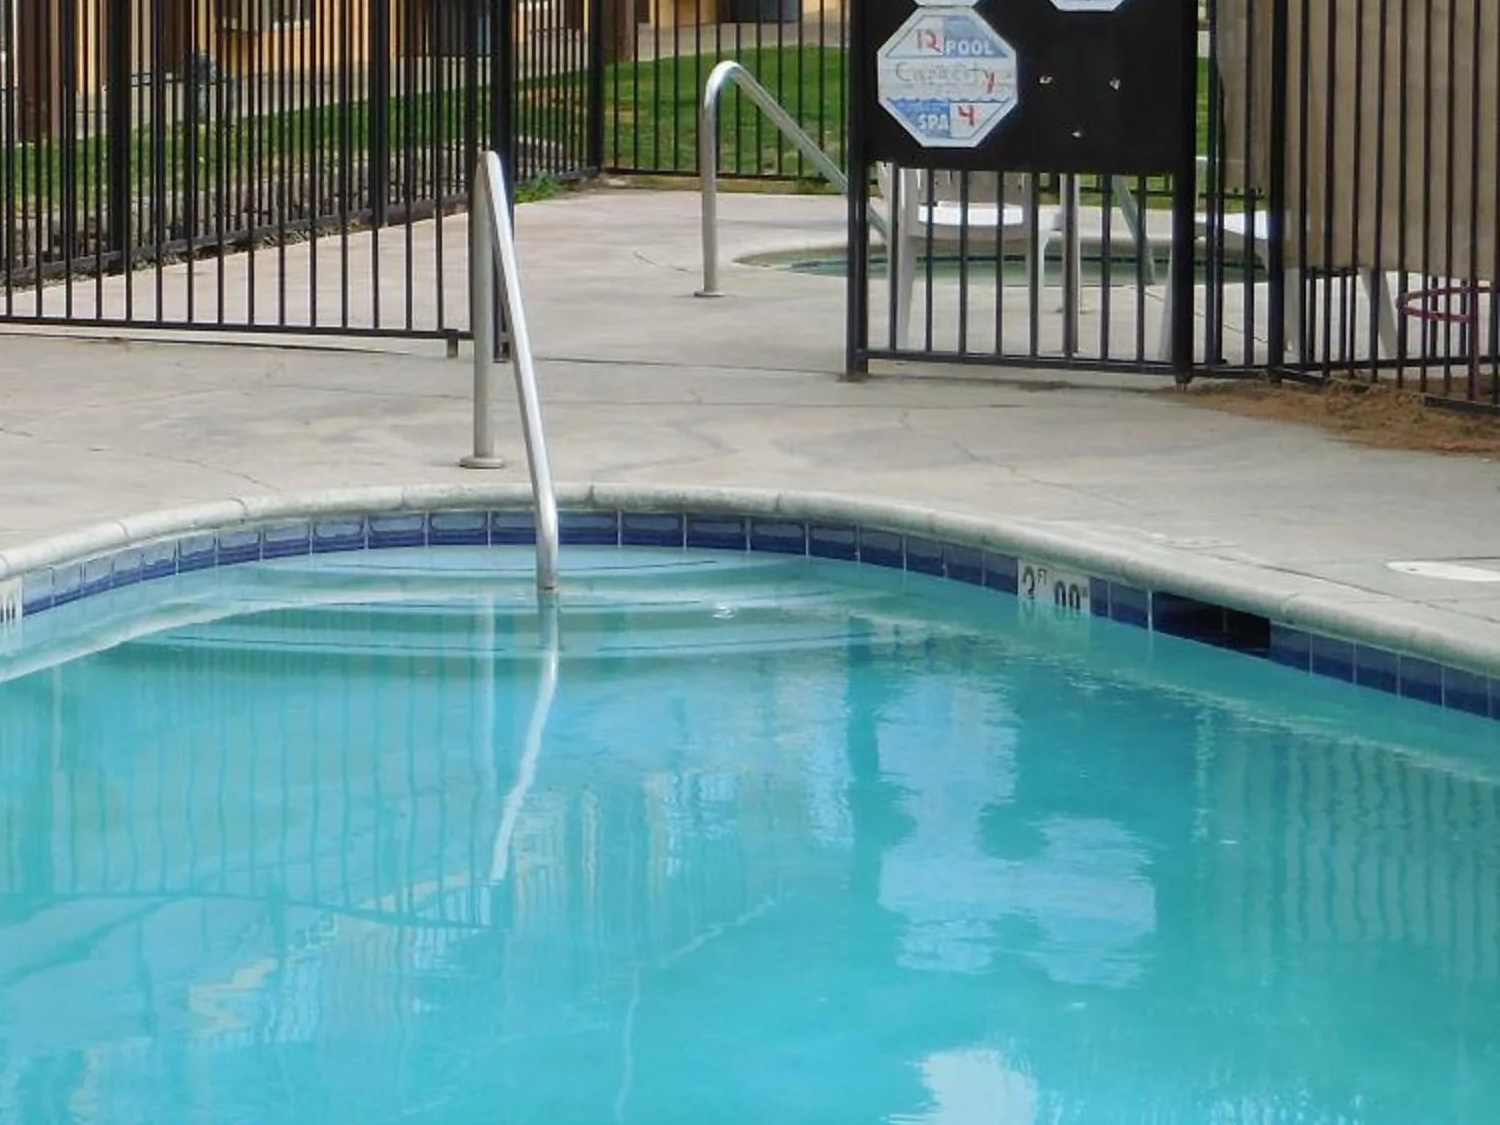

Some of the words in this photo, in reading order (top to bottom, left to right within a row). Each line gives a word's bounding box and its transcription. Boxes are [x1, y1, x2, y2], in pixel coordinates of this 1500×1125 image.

[945, 39, 995, 55] POOL
[917, 114, 948, 130] SPA
[957, 105, 975, 125] 4
